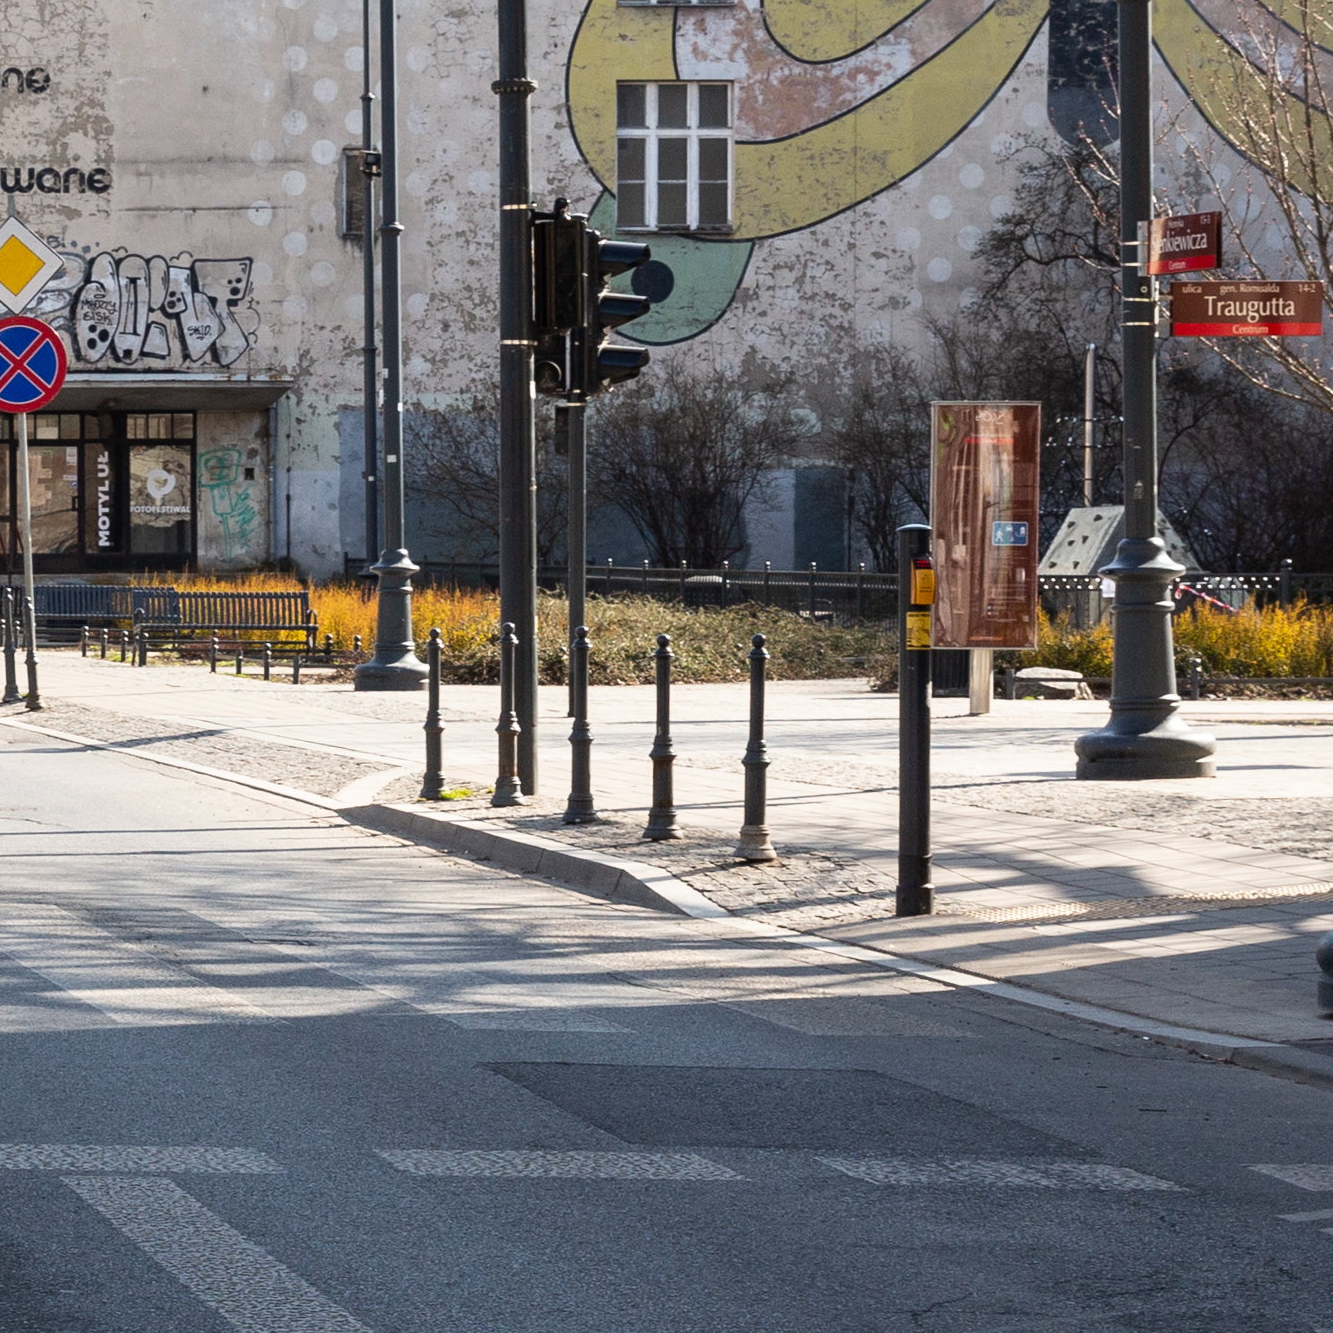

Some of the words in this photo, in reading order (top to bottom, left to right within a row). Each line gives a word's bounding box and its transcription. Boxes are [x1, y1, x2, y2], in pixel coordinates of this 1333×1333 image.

[1182, 285, 1202, 293] ulica
[1220, 286, 1237, 296] gen.
[1239, 284, 1280, 293] Romualda
[1298, 284, 1316, 293] 14-2
[1204, 296, 1296, 323] Traugutta
[1232, 324, 1269, 334] Centrum
[97, 480, 110, 546] MOTYL
